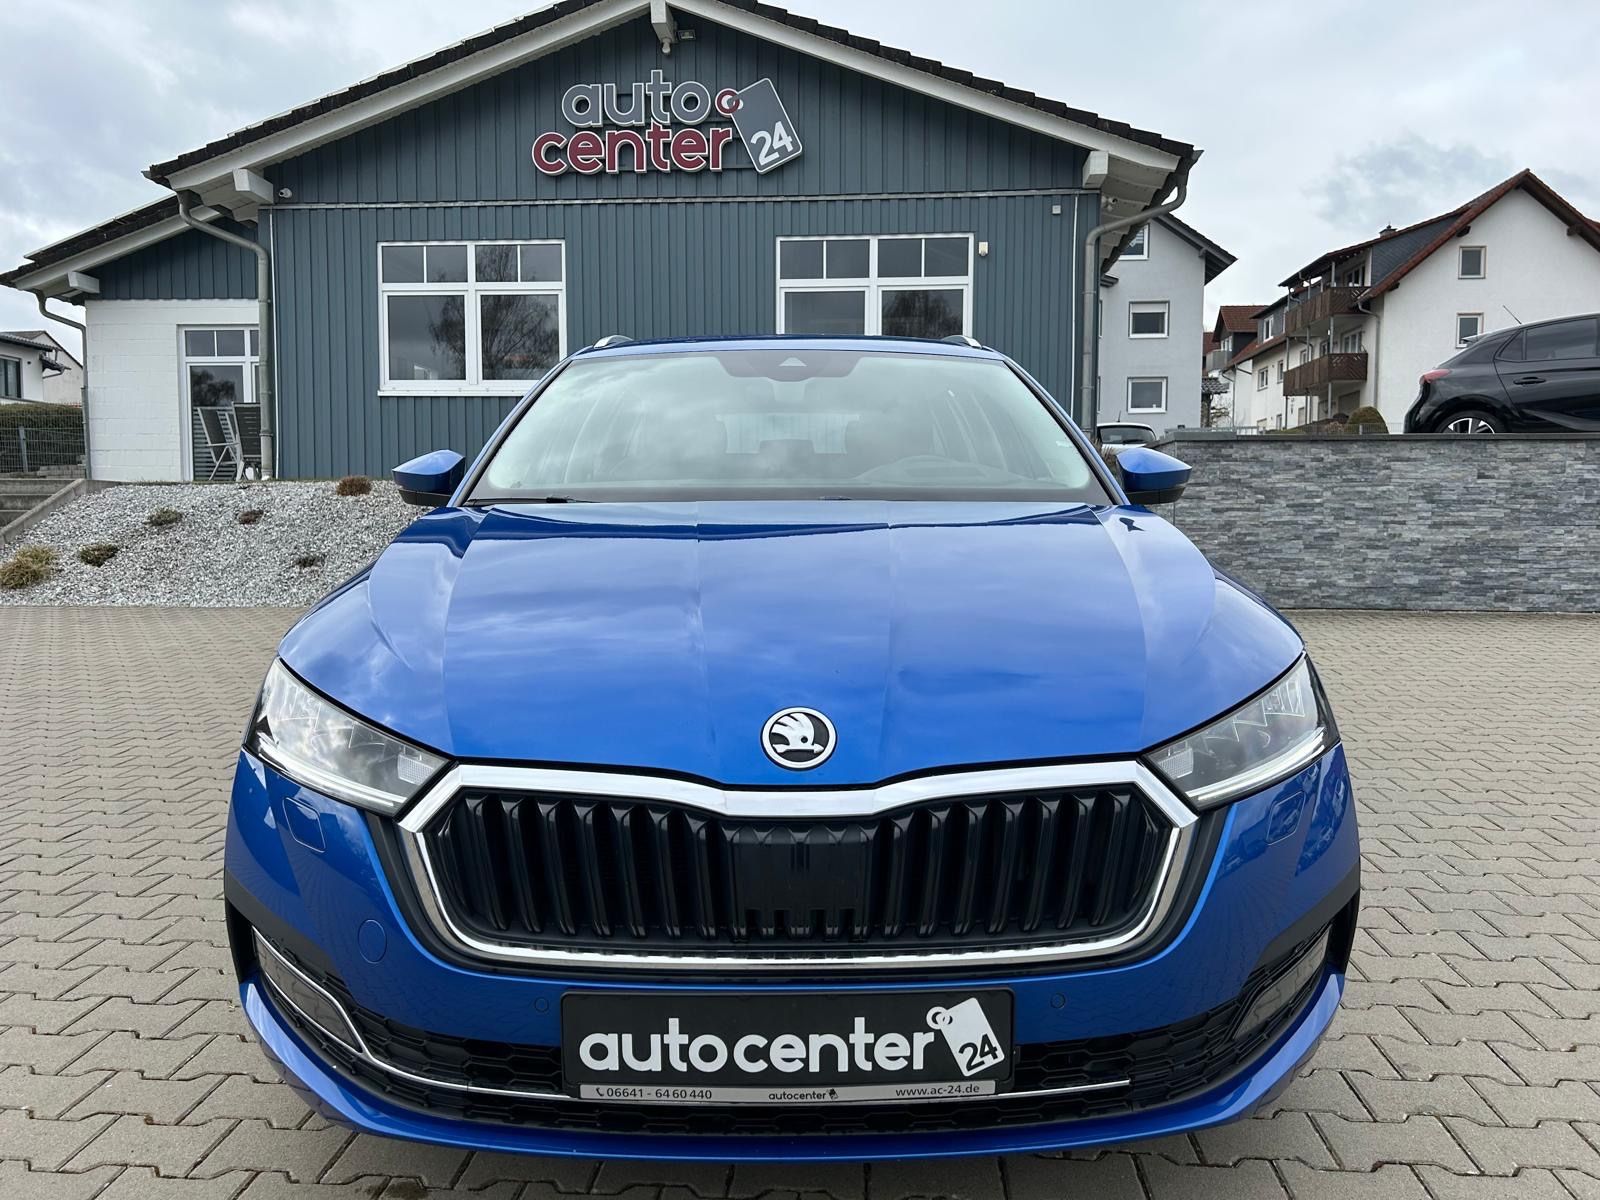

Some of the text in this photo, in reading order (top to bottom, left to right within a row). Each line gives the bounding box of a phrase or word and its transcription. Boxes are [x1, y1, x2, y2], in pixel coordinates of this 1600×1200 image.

[561, 69, 711, 127] auto
[531, 117, 733, 174] center
[750, 121, 794, 166] 24
[958, 1033, 998, 1072] 24
[606, 1087, 643, 1098] 06641
[768, 1090, 827, 1100] autocenter
[895, 1084, 980, 1097] www.ac-24.de
